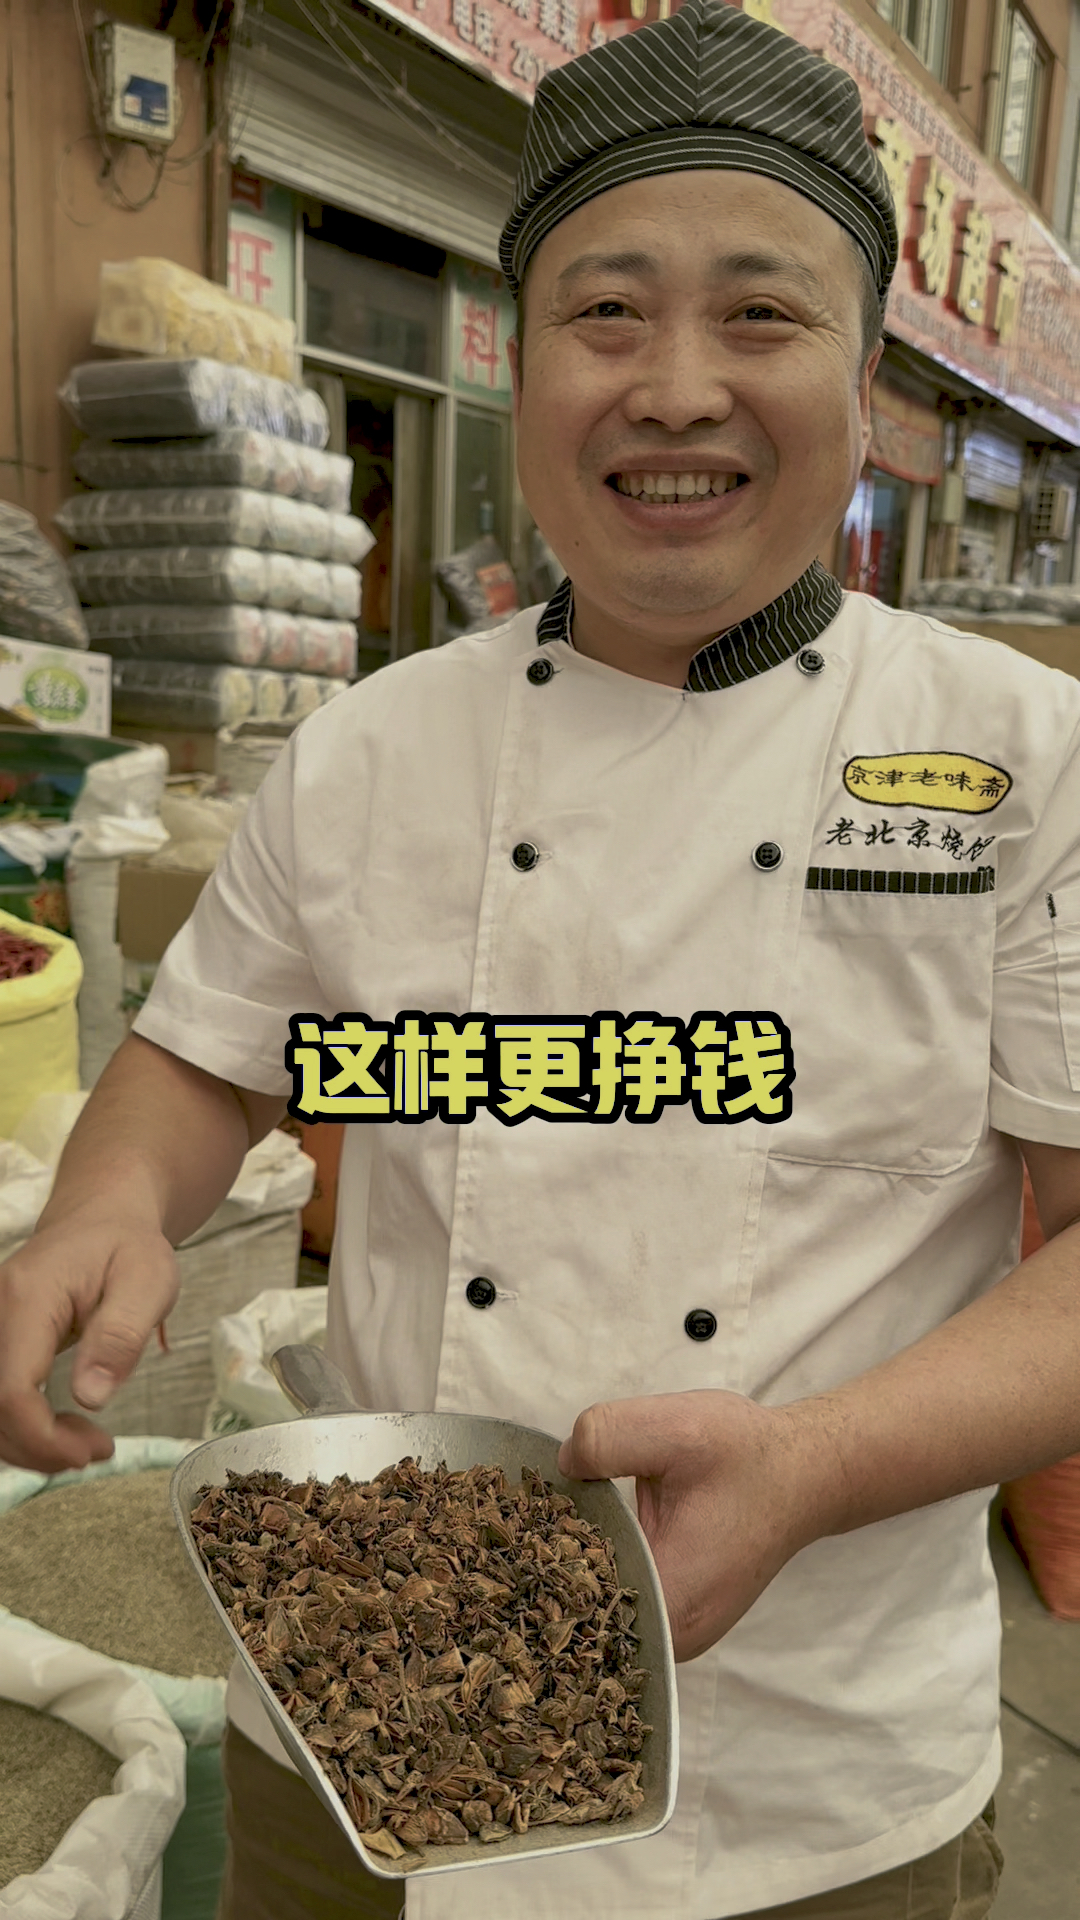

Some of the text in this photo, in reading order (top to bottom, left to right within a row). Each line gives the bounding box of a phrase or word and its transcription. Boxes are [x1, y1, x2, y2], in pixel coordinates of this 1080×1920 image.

[847, 764, 1005, 798] 京津老味斋
